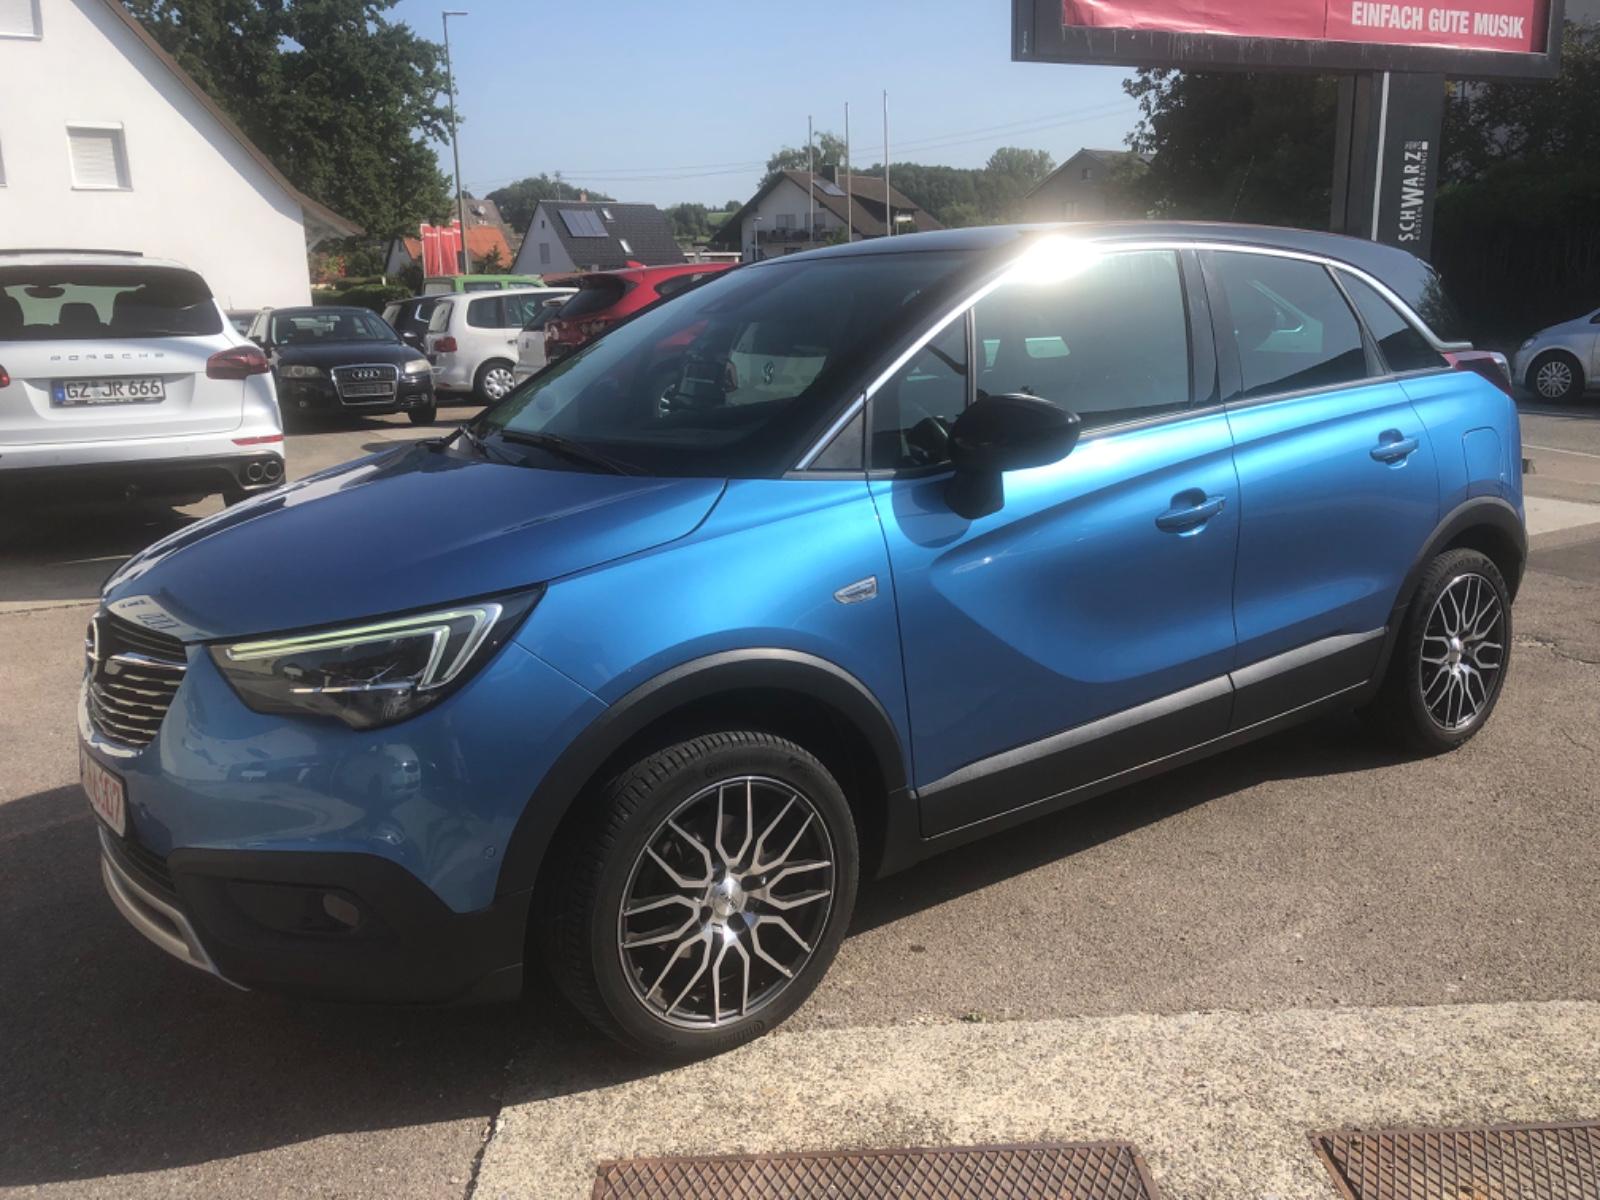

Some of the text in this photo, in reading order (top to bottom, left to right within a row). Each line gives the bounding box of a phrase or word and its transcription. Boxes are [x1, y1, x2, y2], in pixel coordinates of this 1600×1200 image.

[1351, 1, 1525, 39] EINFACH GUTE MUSIK
[1398, 152, 1425, 242] SCHWARZ
[66, 379, 160, 399] GZ JR 666
